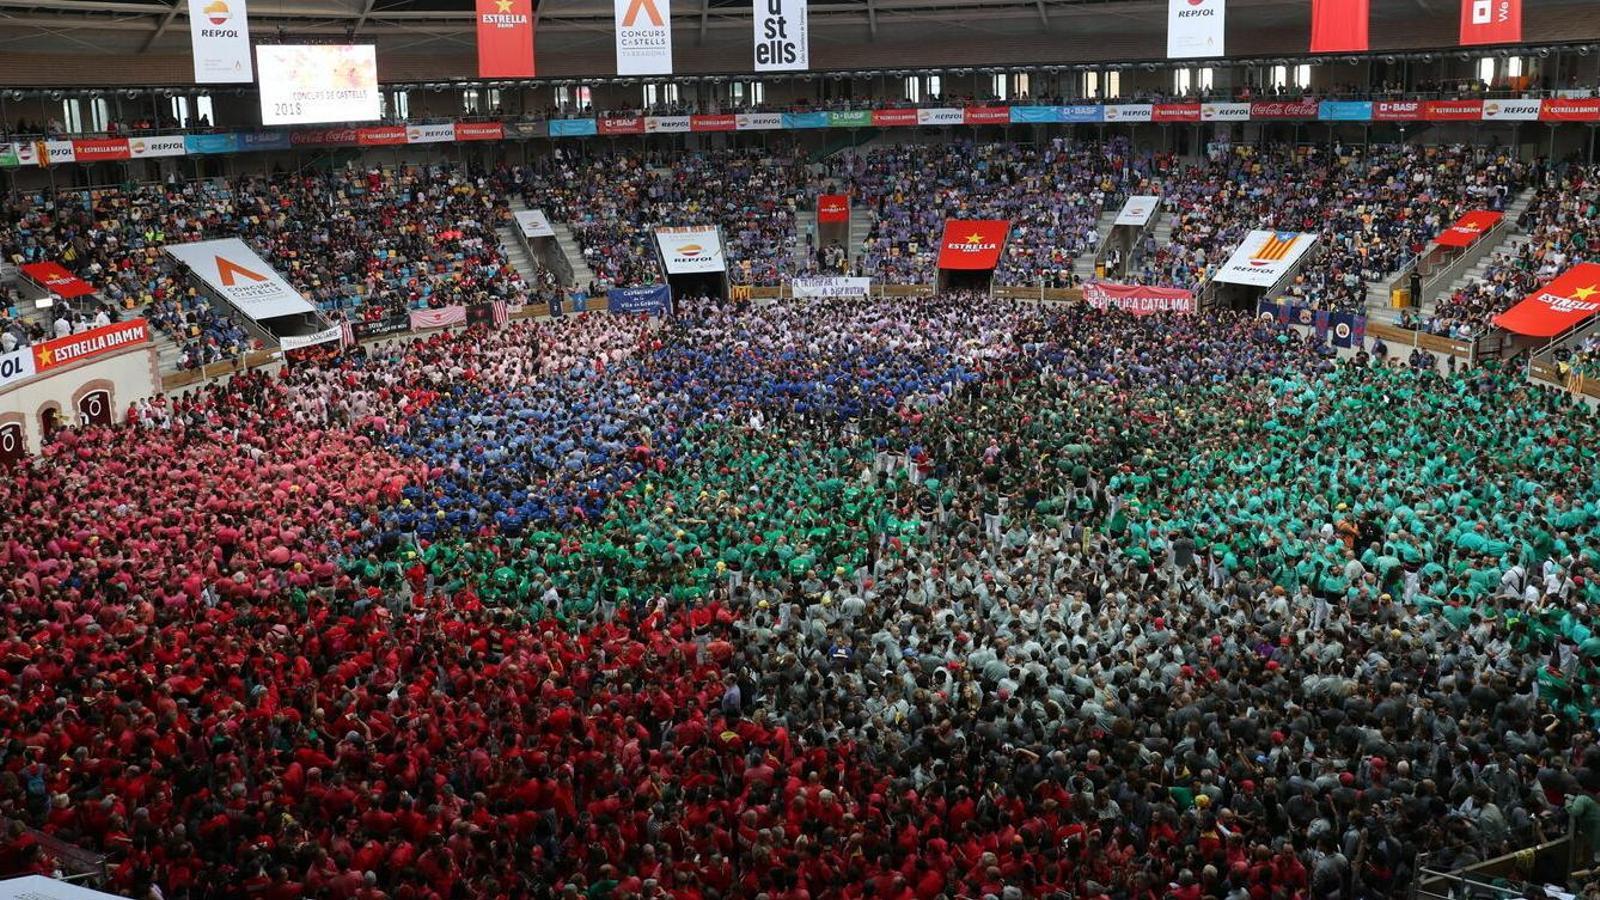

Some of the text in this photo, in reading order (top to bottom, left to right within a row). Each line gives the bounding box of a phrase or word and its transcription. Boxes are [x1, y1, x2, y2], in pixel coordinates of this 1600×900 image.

[1178, 8, 1214, 18] REPSOL
[482, 14, 526, 24] ESTRELLA
[764, 16, 788, 39] st
[201, 29, 238, 38] REPSOL
[756, 40, 796, 64] ells
[274, 102, 302, 116] 2018
[1392, 103, 1418, 111] BASF
[152, 142, 183, 150] REPSOL
[1233, 266, 1274, 274] REPSOL
[227, 281, 276, 292] CONCURS
[1538, 294, 1600, 310] ESTRELLA
[54, 326, 144, 362] ESTRELLA DAMM
